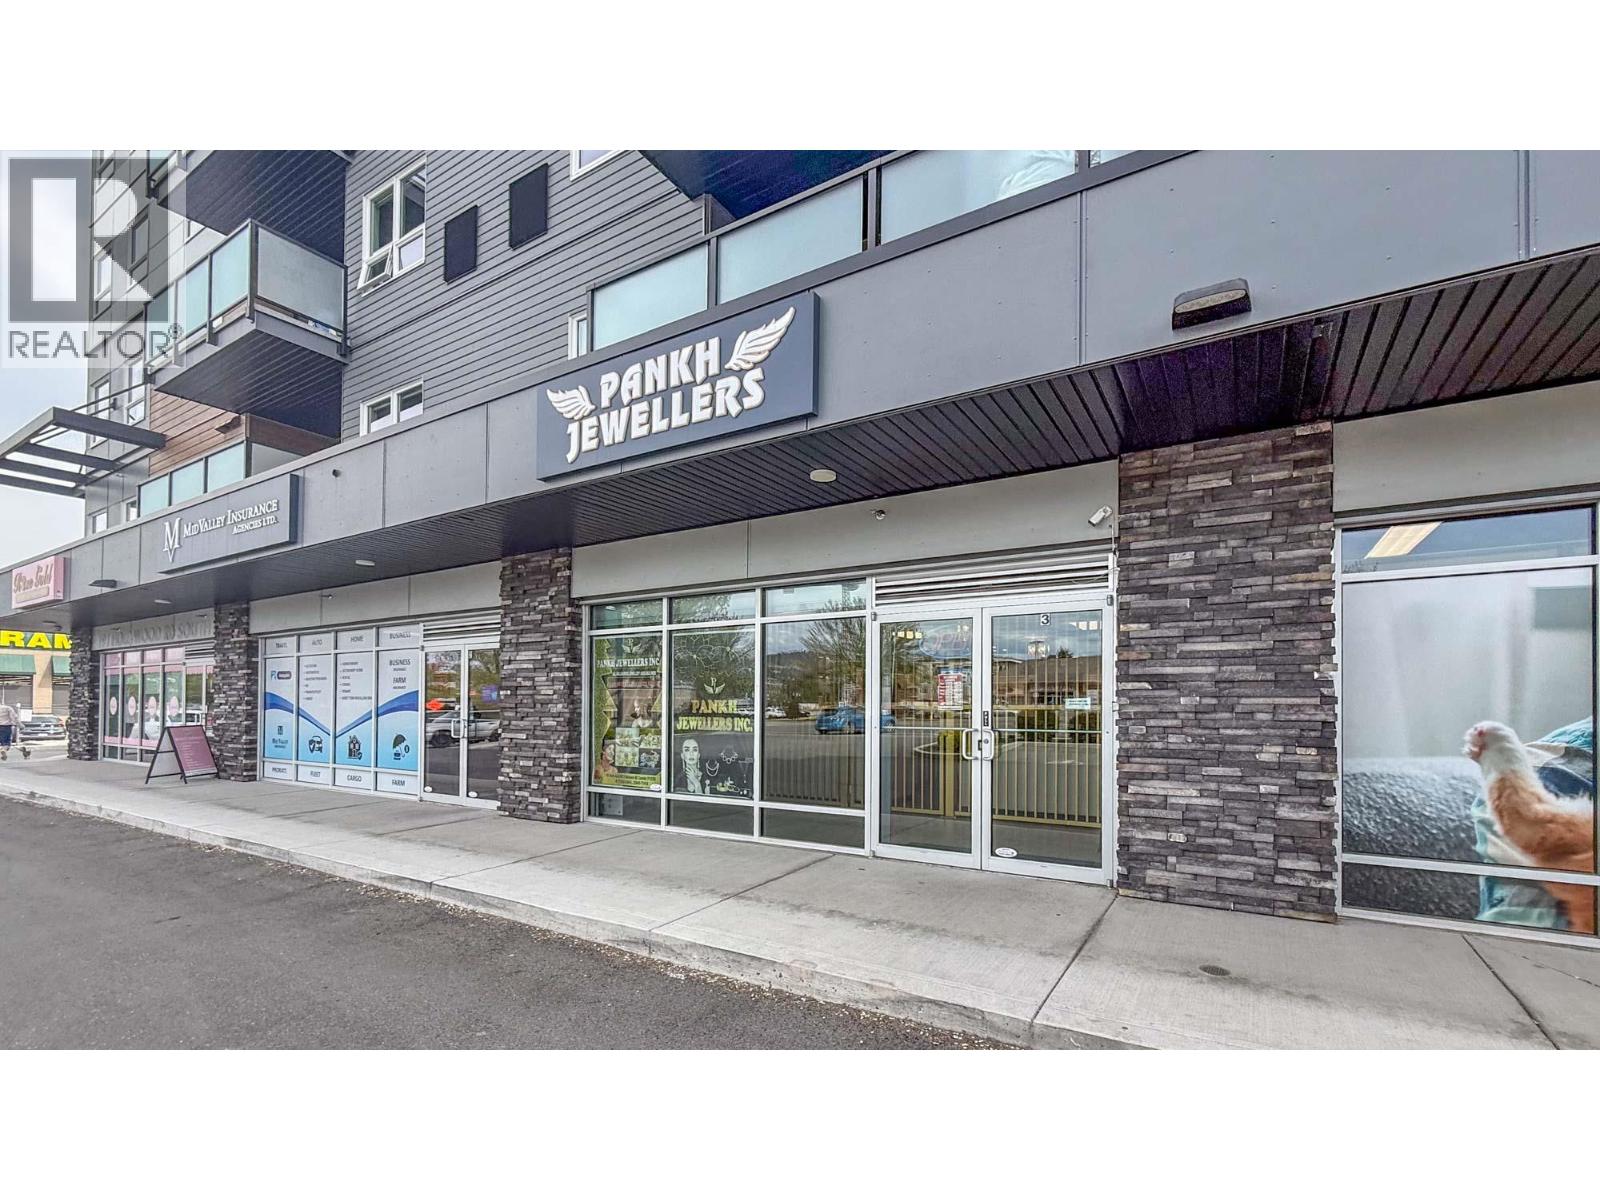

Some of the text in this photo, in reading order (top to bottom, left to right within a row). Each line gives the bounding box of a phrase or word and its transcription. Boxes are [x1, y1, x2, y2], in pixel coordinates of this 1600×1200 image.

[600, 336, 721, 405] PANKH
[566, 367, 765, 464] JEWELLERS
[227, 500, 278, 525] INSURANCE
[232, 519, 262, 534] AGENCIES
[1041, 614, 1050, 624] 3
[616, 658, 648, 667] JEWELLERS
[691, 699, 738, 714] PANKH
[677, 716, 753, 732] JEWELLERS INC.
[347, 774, 362, 782] CARGO
[391, 779, 406, 787] FARM
